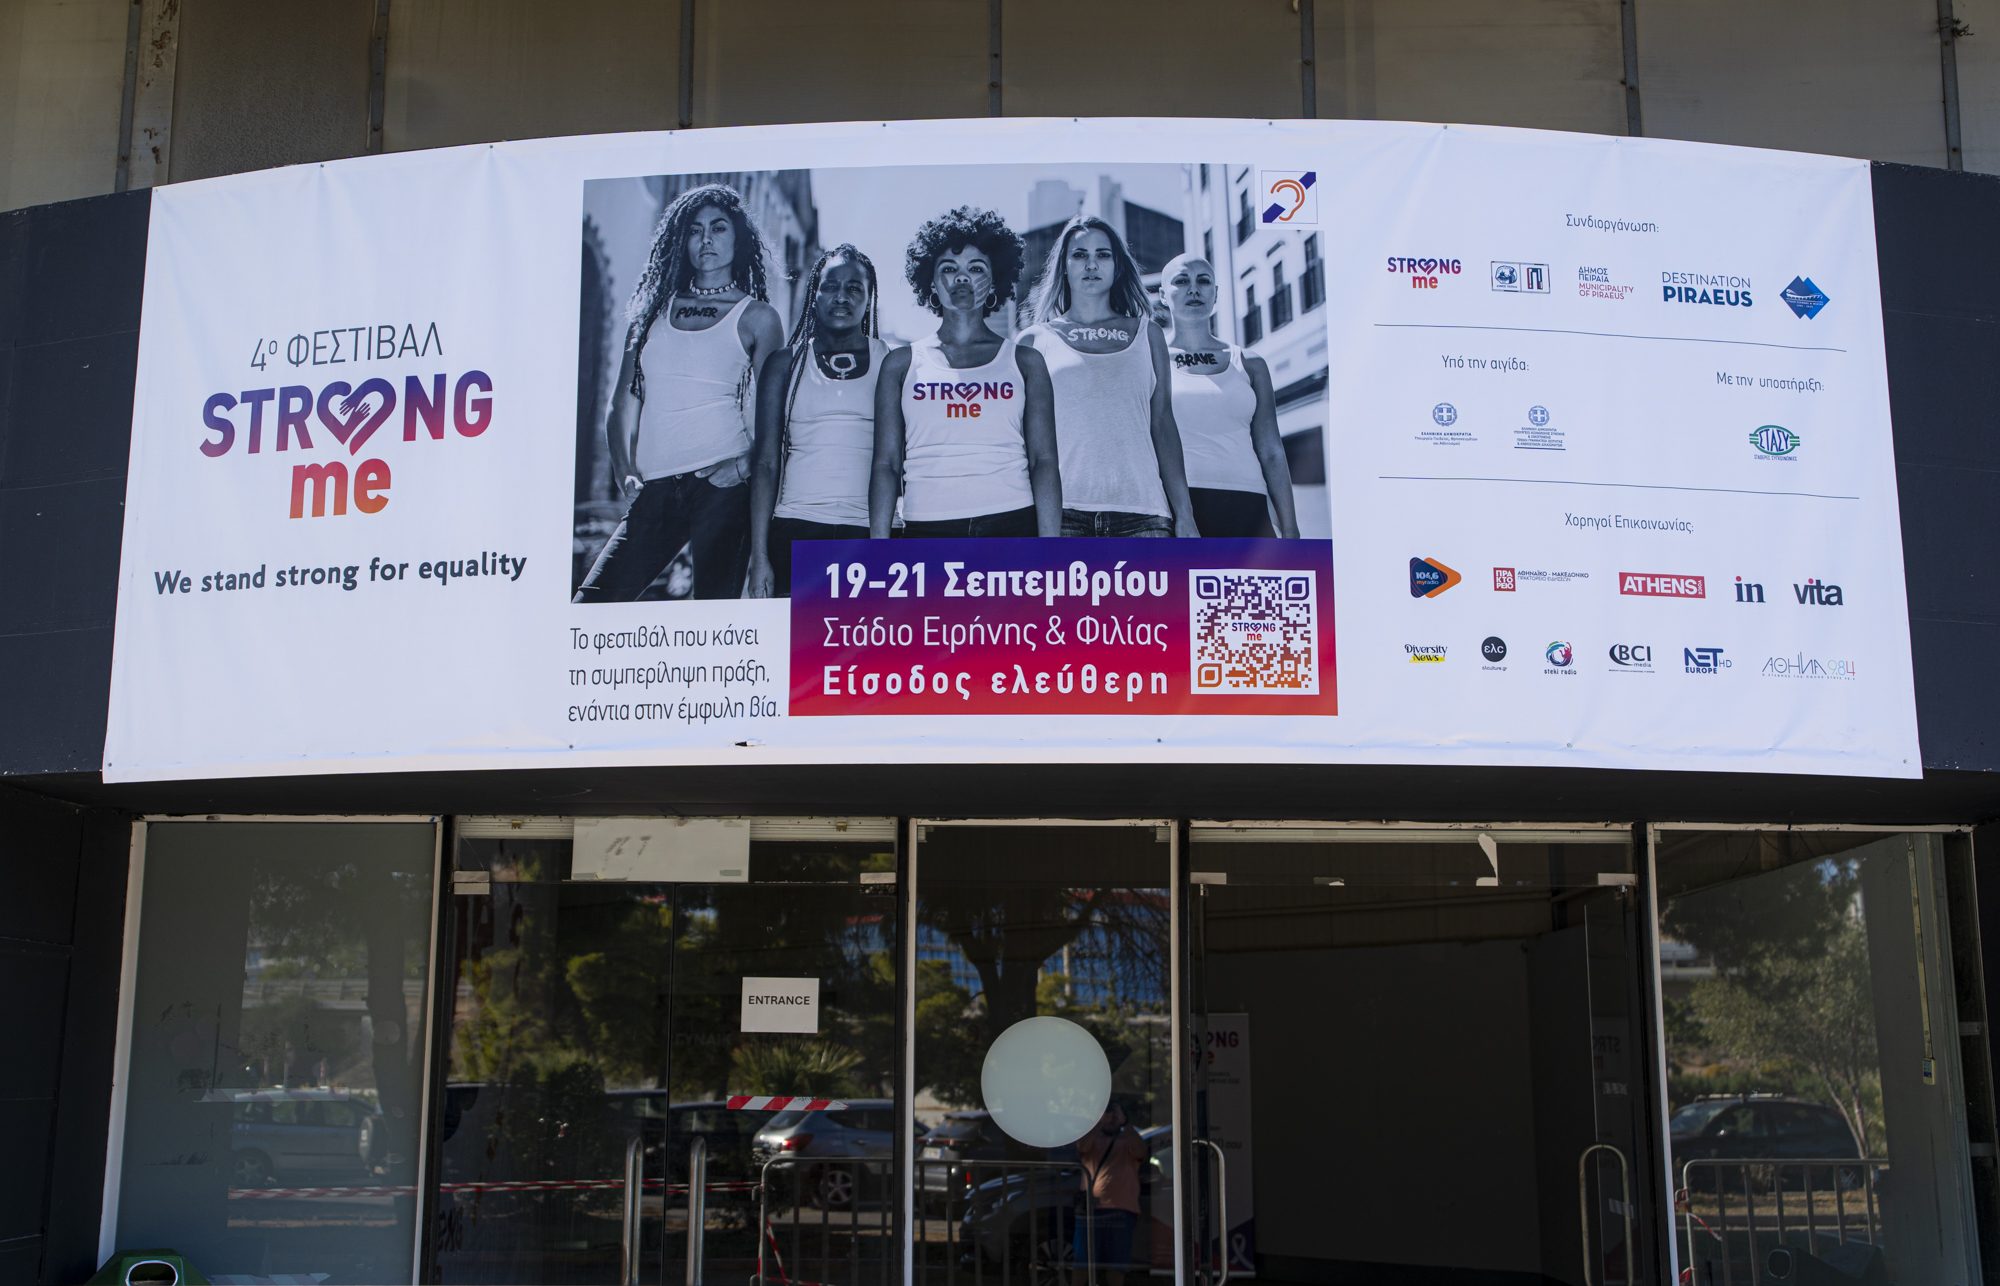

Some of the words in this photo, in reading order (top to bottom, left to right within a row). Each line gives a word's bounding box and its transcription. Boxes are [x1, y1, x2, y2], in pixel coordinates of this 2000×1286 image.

[1566, 213, 1660, 234] Συνδιοργάνωση:
[1387, 257, 1461, 276] STRONG
[1579, 266, 1608, 275] ΔΗΜΟΣ
[1412, 275, 1438, 289] me
[1578, 274, 1609, 283] ΠΕΙΡΑΙΑ
[1579, 282, 1634, 293] MUNICIPALITY
[1662, 272, 1751, 288] DESTINATION
[1592, 290, 1625, 300] PIRAEUS
[1663, 286, 1753, 307] PIRAEUS
[676, 306, 719, 320] POWER
[287, 322, 443, 367] ΦΕΣΤΙΒΑΛ
[1068, 327, 1129, 344] STRONG
[1175, 352, 1218, 369] BRAVE
[1442, 354, 1465, 369] Υπό
[1467, 357, 1487, 371] την
[1490, 356, 1530, 374] αιγίδα:
[1717, 371, 1733, 385] Με
[1735, 374, 1753, 387] την
[1759, 376, 1825, 393] υποστήριξη:
[913, 382, 1013, 402] STRONG
[200, 370, 493, 457] STRONG
[946, 400, 981, 418] me
[1759, 428, 1789, 452] ΣΤΑΣΥ
[289, 458, 391, 519] me
[1565, 512, 1612, 530] Χορηγοί
[1615, 515, 1694, 534] Επικοινωνίας:
[154, 570, 191, 595] We
[201, 564, 266, 592] stand
[275, 565, 359, 590] strong
[369, 557, 409, 582] for
[418, 551, 527, 586] equality
[1552, 571, 1589, 579] ΜΑΚΕΔΟΝΙΚΟ
[943, 560, 1169, 606] Σεπτεμβρίου
[1623, 576, 1697, 595] ATHENS
[1734, 576, 1766, 603] in
[1793, 578, 1843, 605] vita
[823, 616, 913, 647] Στάδιο
[923, 615, 1037, 652] Ειρήνης
[1045, 616, 1066, 646] &
[1076, 615, 1169, 652] Φιλίας
[1231, 621, 1276, 633] STRONG
[570, 627, 588, 649] Το
[594, 625, 669, 655] φεστιβάλ
[674, 630, 707, 647] που
[712, 623, 759, 646] κάνει
[1246, 632, 1262, 642] me
[1404, 644, 1448, 657] Diversity
[1413, 652, 1439, 661] News
[1618, 645, 1651, 662] BCI
[1684, 647, 1724, 667] NET
[1719, 659, 1732, 668] HD
[569, 669, 586, 685] τη
[592, 661, 706, 690] συμπερίληψη
[712, 659, 770, 688] πράξη,
[823, 664, 971, 701] Είσοδος
[991, 663, 1168, 702] ελεύθερη
[569, 699, 629, 721] ενάντια
[634, 703, 673, 720] στην
[678, 697, 744, 724] έμφυλη
[750, 695, 781, 718] βία.
[748, 995, 810, 1006] ENTRANCE
